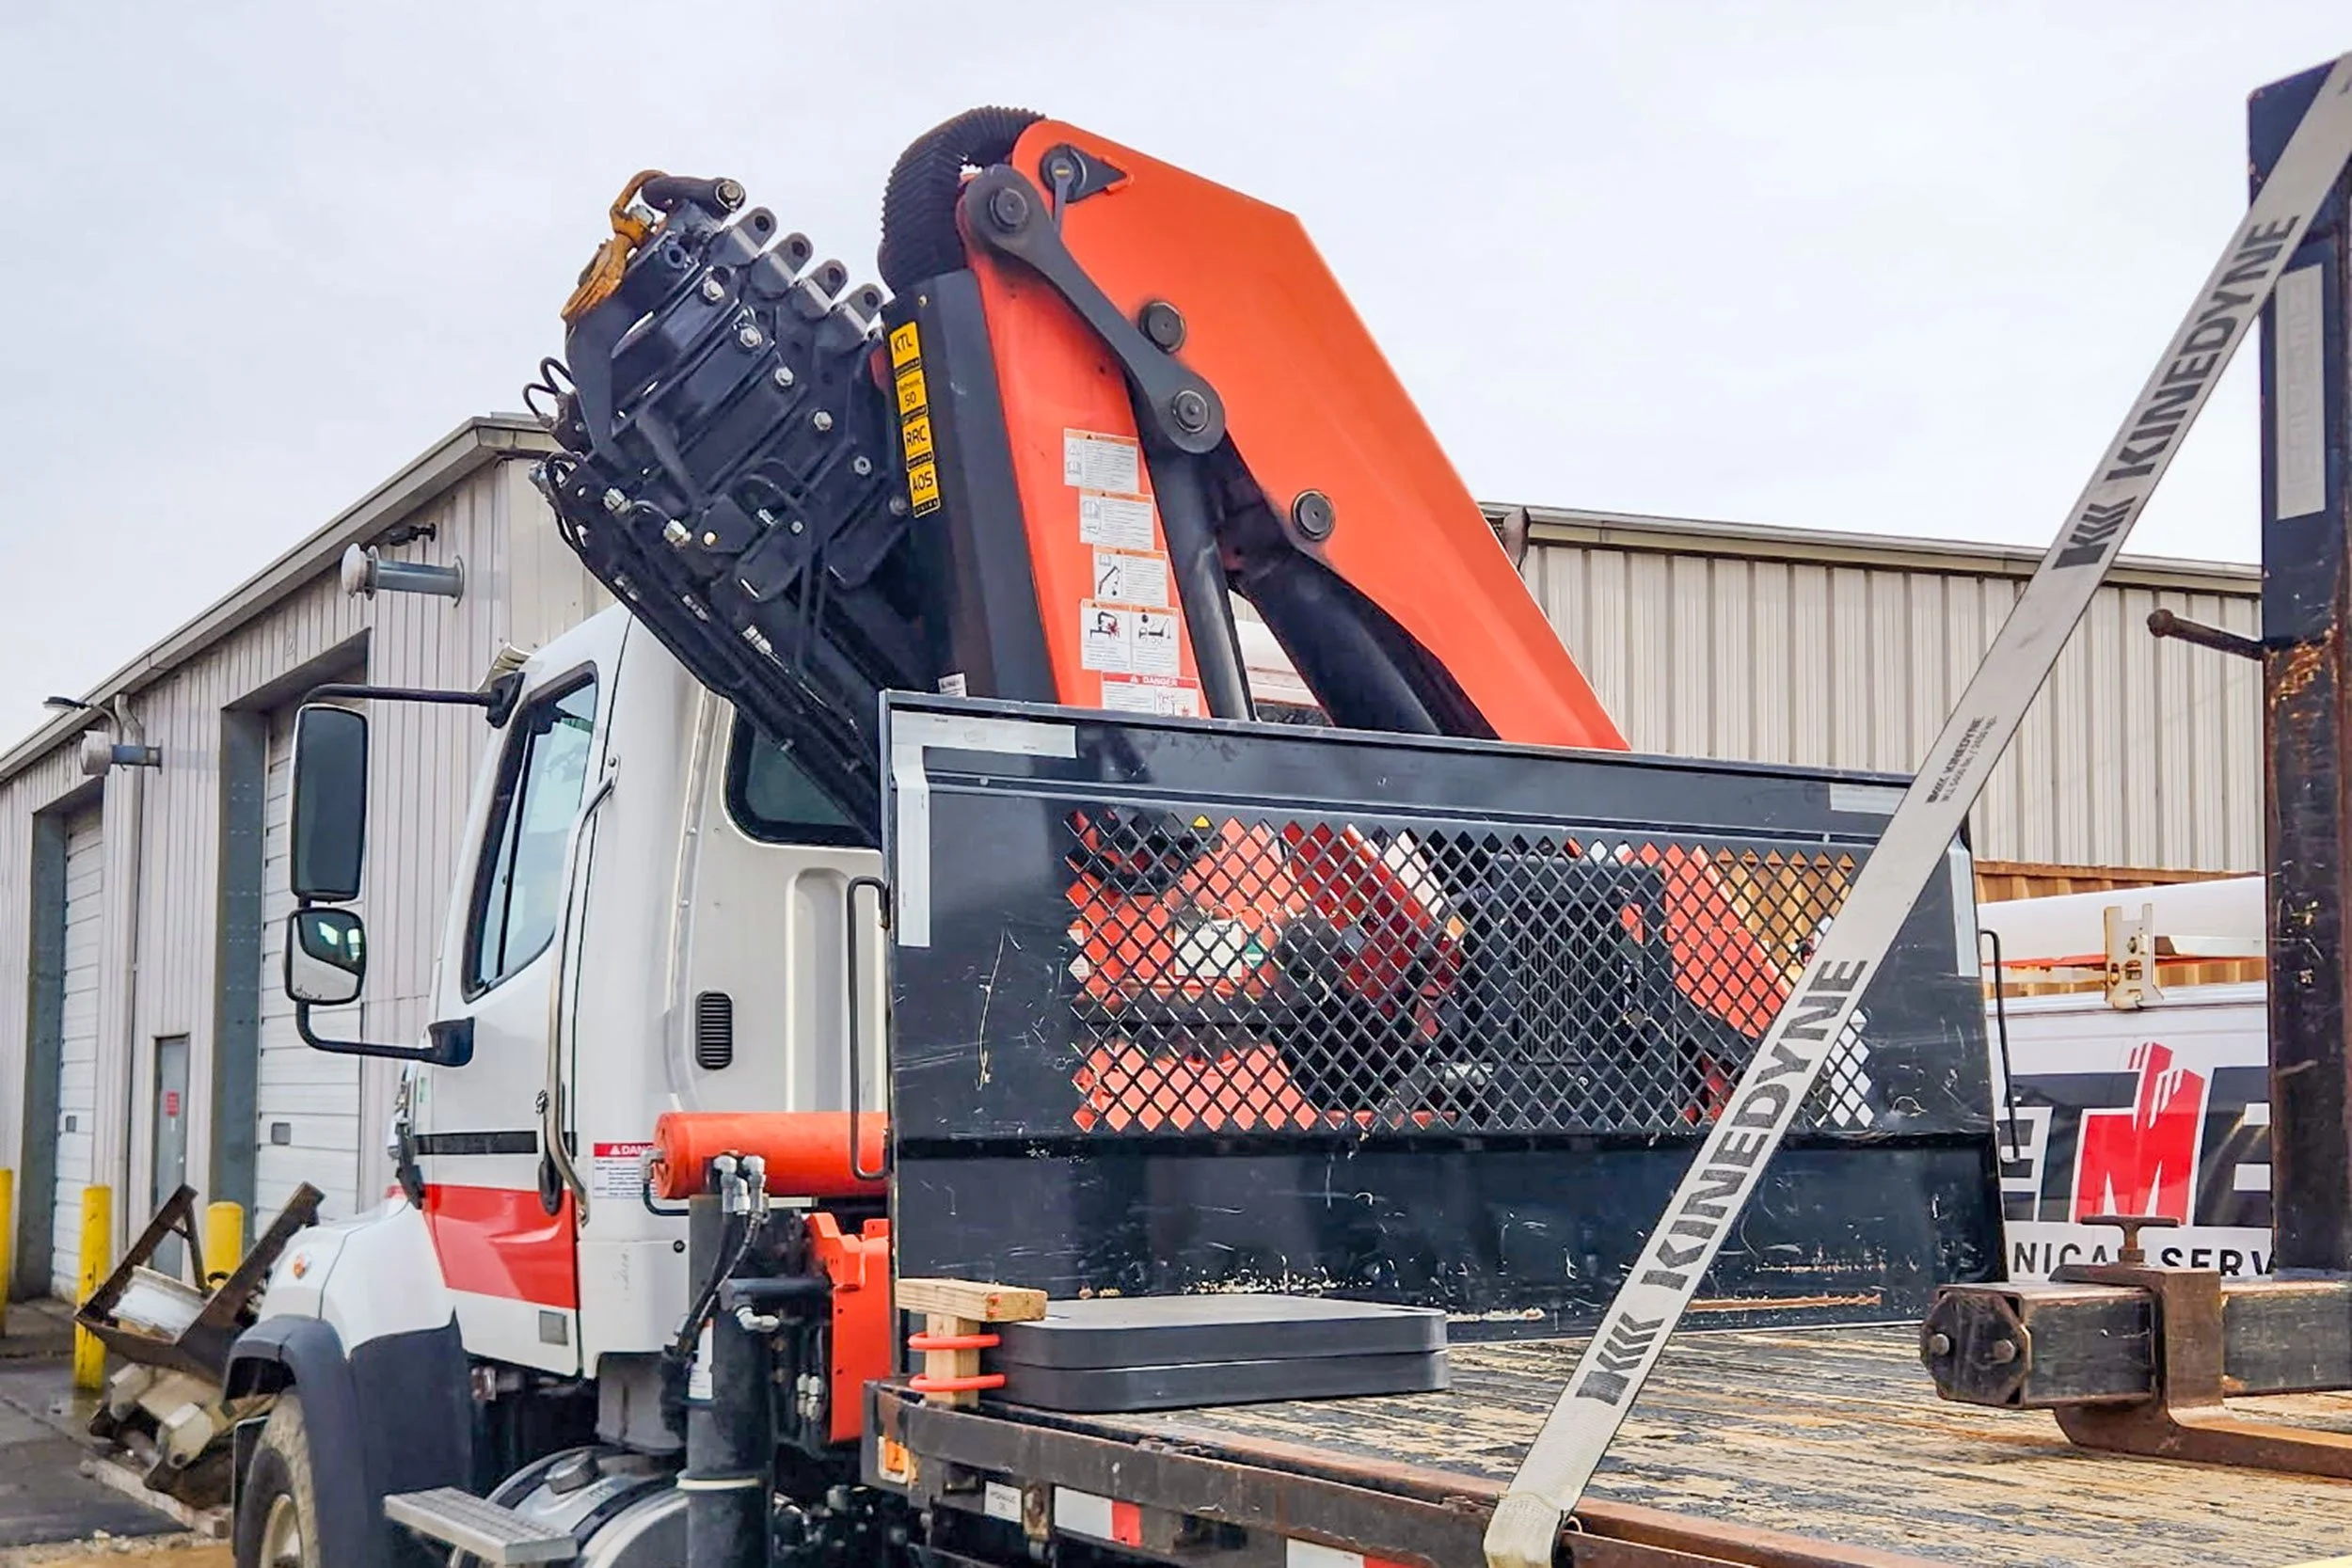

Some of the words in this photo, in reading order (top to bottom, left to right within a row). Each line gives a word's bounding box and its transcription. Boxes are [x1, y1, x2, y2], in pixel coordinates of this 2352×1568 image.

[894, 332, 914, 354] KTL
[2105, 214, 2301, 483] KINEDYNE
[905, 425, 928, 449] RRC
[912, 471, 934, 494] AOS
[1141, 674, 1179, 688] DANGER
[1640, 959, 1869, 1292] KINEDYNE
